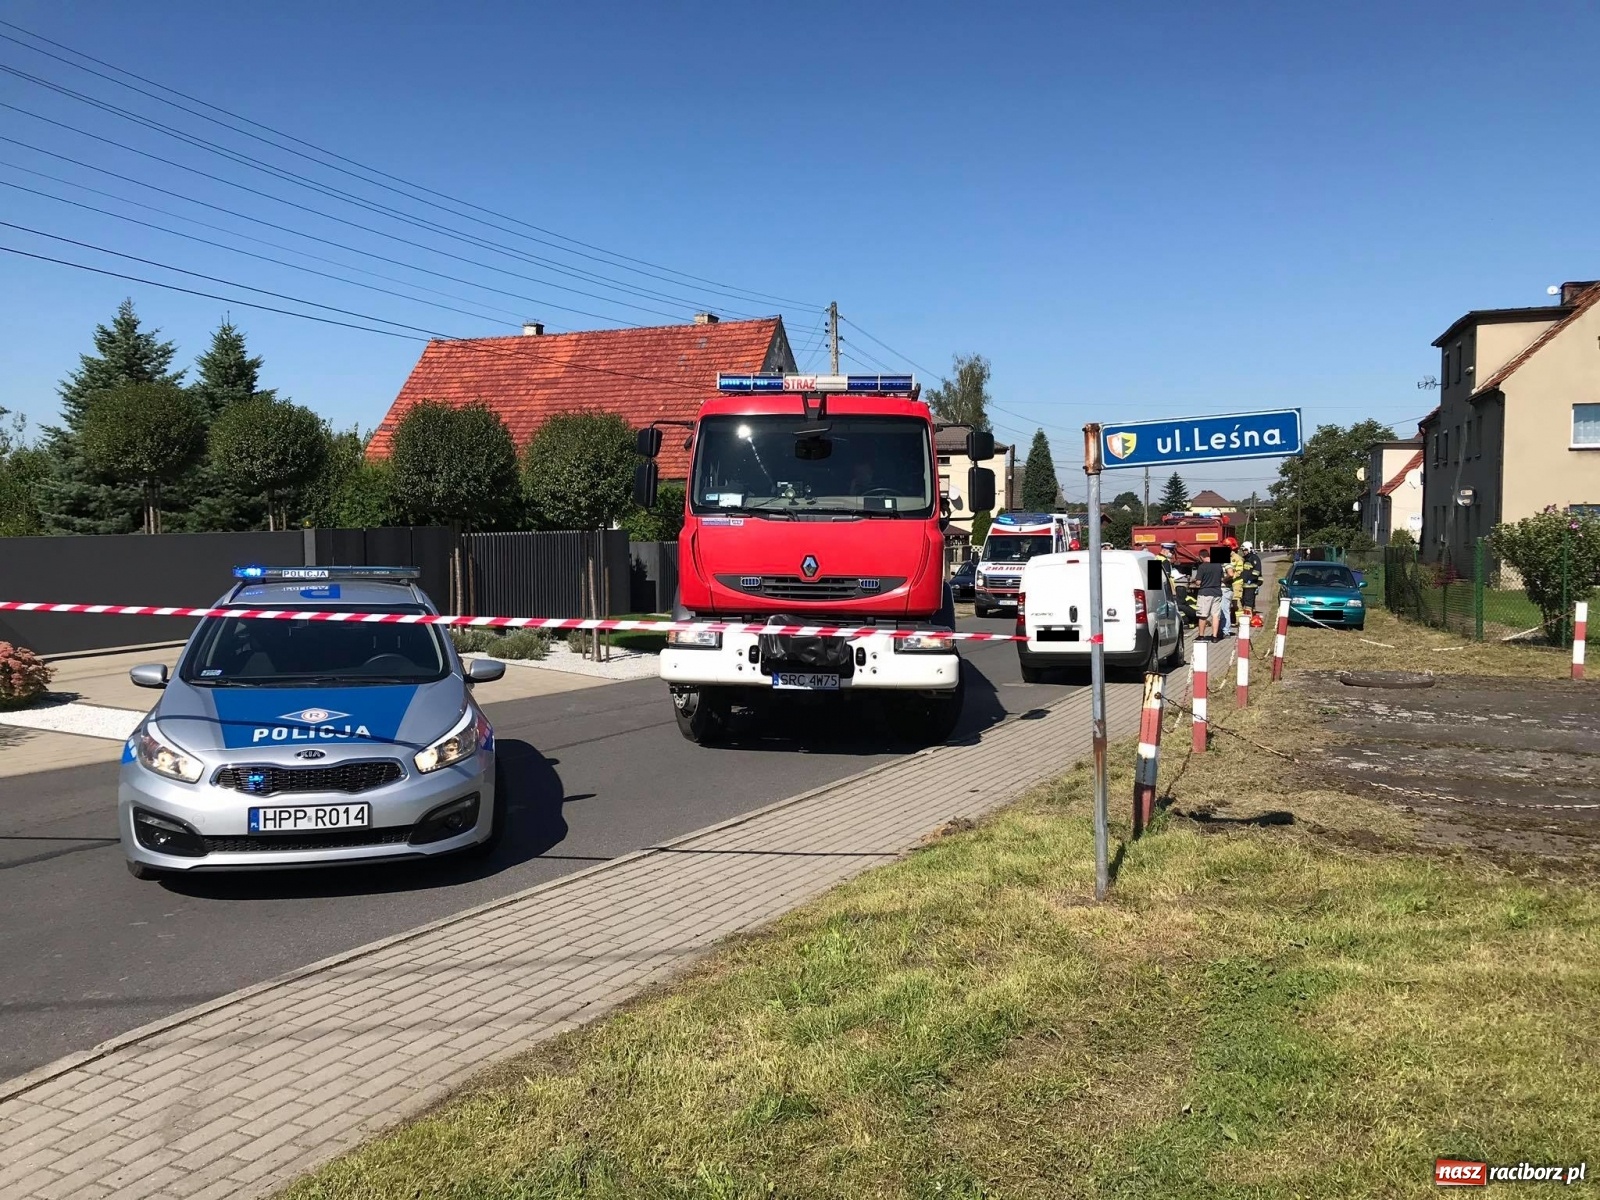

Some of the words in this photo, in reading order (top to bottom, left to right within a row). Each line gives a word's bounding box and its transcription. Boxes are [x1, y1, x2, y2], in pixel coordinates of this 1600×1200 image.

[283, 570, 328, 578] POLICJA
[780, 674, 806, 686] SRC
[809, 674, 838, 687] 4W75
[252, 725, 371, 743] POLICJA
[263, 809, 307, 828] HPP
[315, 806, 365, 827] R014
